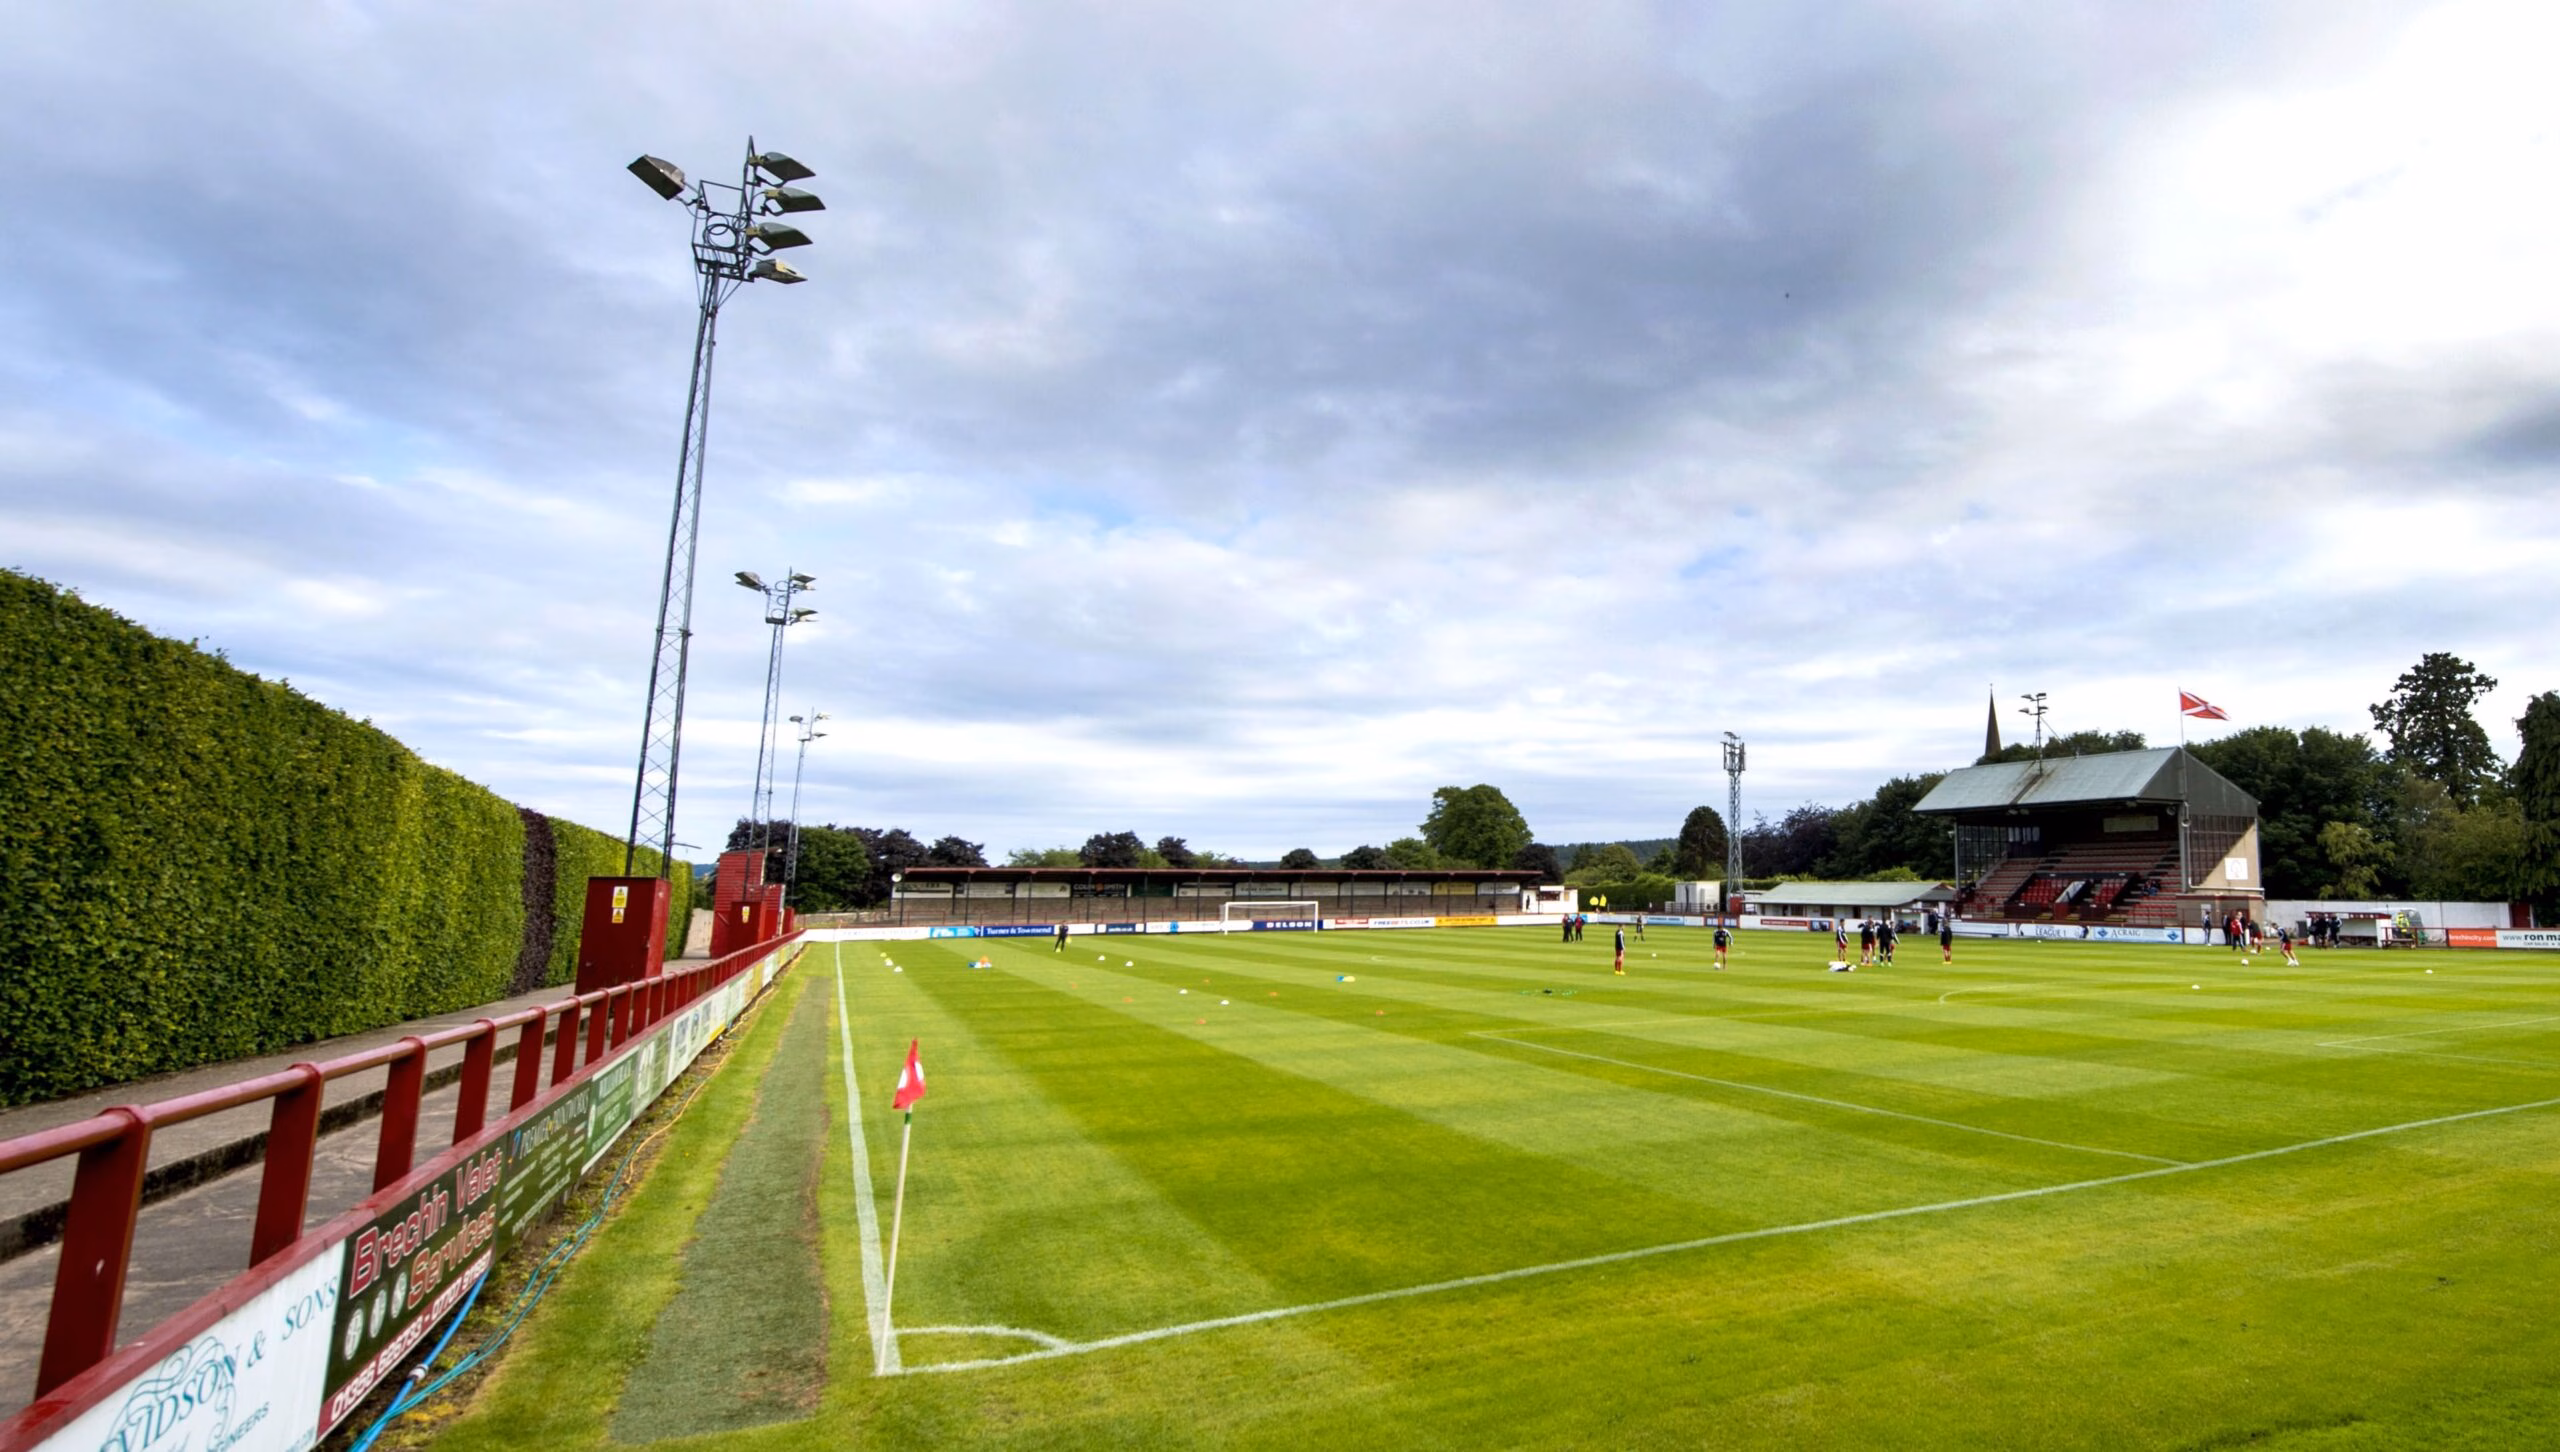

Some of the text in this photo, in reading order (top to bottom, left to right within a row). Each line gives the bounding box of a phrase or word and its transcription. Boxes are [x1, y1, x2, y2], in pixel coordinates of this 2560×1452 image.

[987, 928, 1010, 936] Turner
[1018, 926, 1052, 935] Townsend
[2035, 928, 2061, 937] LEAGUE
[349, 1184, 449, 1300] Brechin
[456, 1147, 503, 1214] Valet
[407, 1203, 497, 1310] Services
[101, 1343, 241, 1452] VIDSON
[247, 1331, 266, 1367] &
[282, 1276, 338, 1340] SONS
